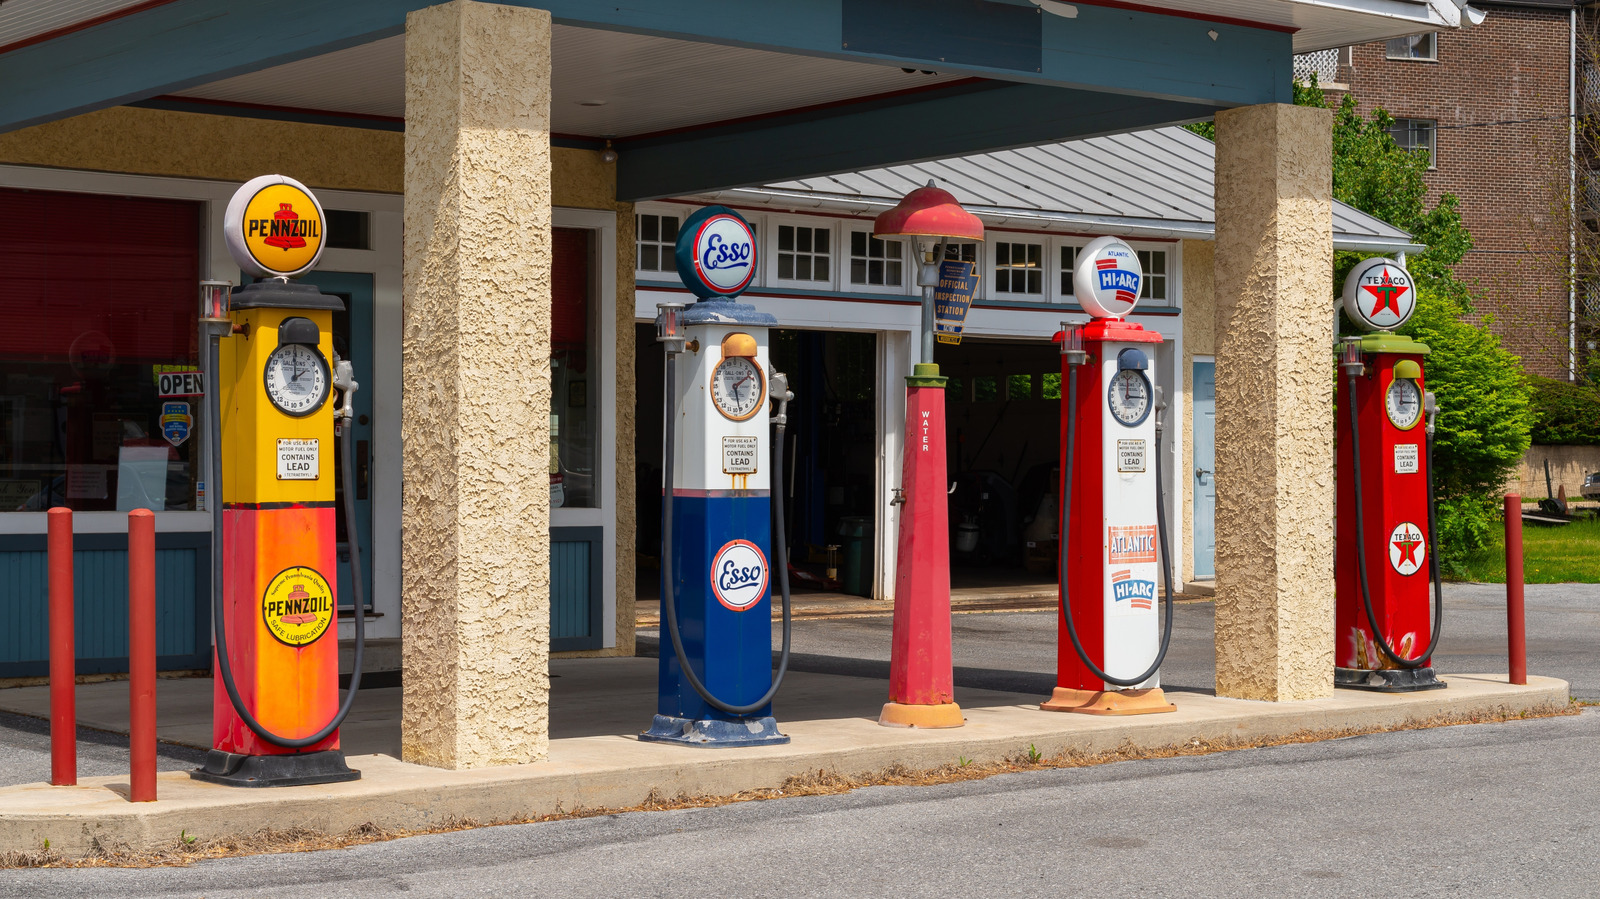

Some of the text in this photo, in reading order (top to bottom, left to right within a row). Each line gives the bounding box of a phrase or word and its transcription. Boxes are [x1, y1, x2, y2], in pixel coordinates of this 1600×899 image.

[248, 219, 319, 238] PENNZOIL
[704, 234, 750, 270] Esso
[940, 279, 968, 290] OFFICIAL
[1102, 273, 1137, 290] HI-ARC
[1366, 277, 1405, 285] TEXACO
[935, 292, 970, 303] INSPECTION
[1377, 287, 1397, 308] T
[937, 305, 964, 315] STATION
[160, 374, 204, 394] OPEN
[1112, 534, 1154, 553] ATLANTIC
[1401, 542, 1413, 559] T
[720, 560, 760, 590] Esso
[1116, 582, 1152, 598] HI-ARC
[268, 596, 329, 617] PENNZOIL
[271, 617, 326, 641] SAFE LUBRICATION
